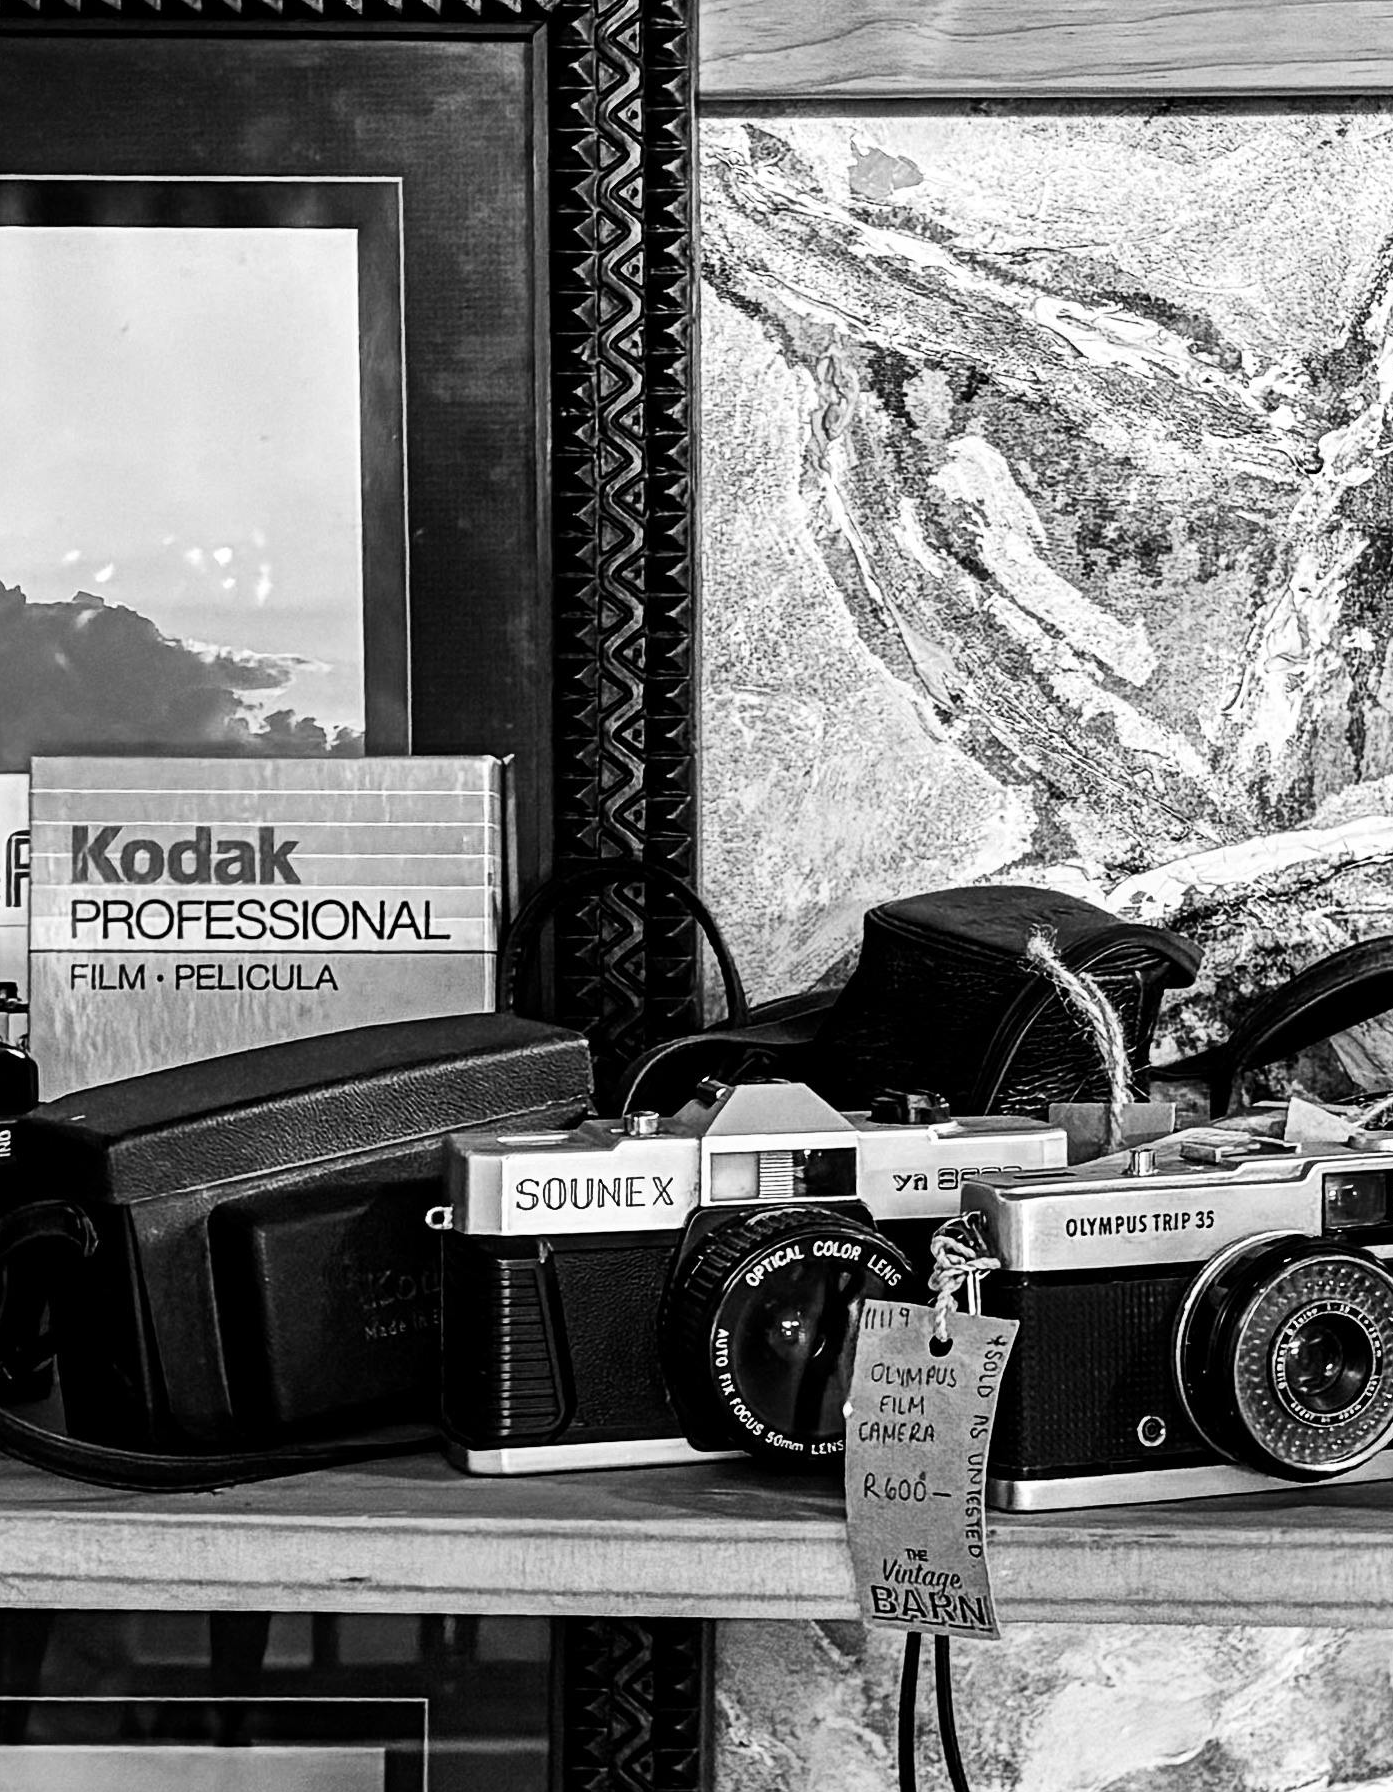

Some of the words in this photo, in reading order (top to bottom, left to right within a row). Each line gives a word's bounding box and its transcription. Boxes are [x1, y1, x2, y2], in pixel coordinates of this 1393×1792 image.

[71, 825, 303, 885] Kodak
[71, 900, 451, 941] PROFESSIONAL
[70, 964, 145, 991] FILM
[175, 964, 339, 991] PELICULA
[515, 1177, 675, 1212] SOUNEX
[1065, 1214, 1147, 1237] OLYMPUS
[1151, 1212, 1191, 1233] TRIP
[1195, 1210, 1215, 1230] 35
[745, 1245, 804, 1287] OPTICAL
[812, 1240, 862, 1261] COLOR
[867, 1255, 902, 1287] LENS
[714, 1328, 730, 1368] AUTO
[718, 1371, 735, 1396] FIX
[870, 1362, 958, 1388] OLYMPUS
[729, 1396, 765, 1436] FOCUS
[879, 1396, 926, 1416] FILM
[765, 1431, 804, 1452] 50mm
[811, 1439, 845, 1455] LENS
[858, 1422, 936, 1444] CAMERA
[882, 1558, 963, 1597] Vintage
[870, 1585, 987, 1626] BARN
